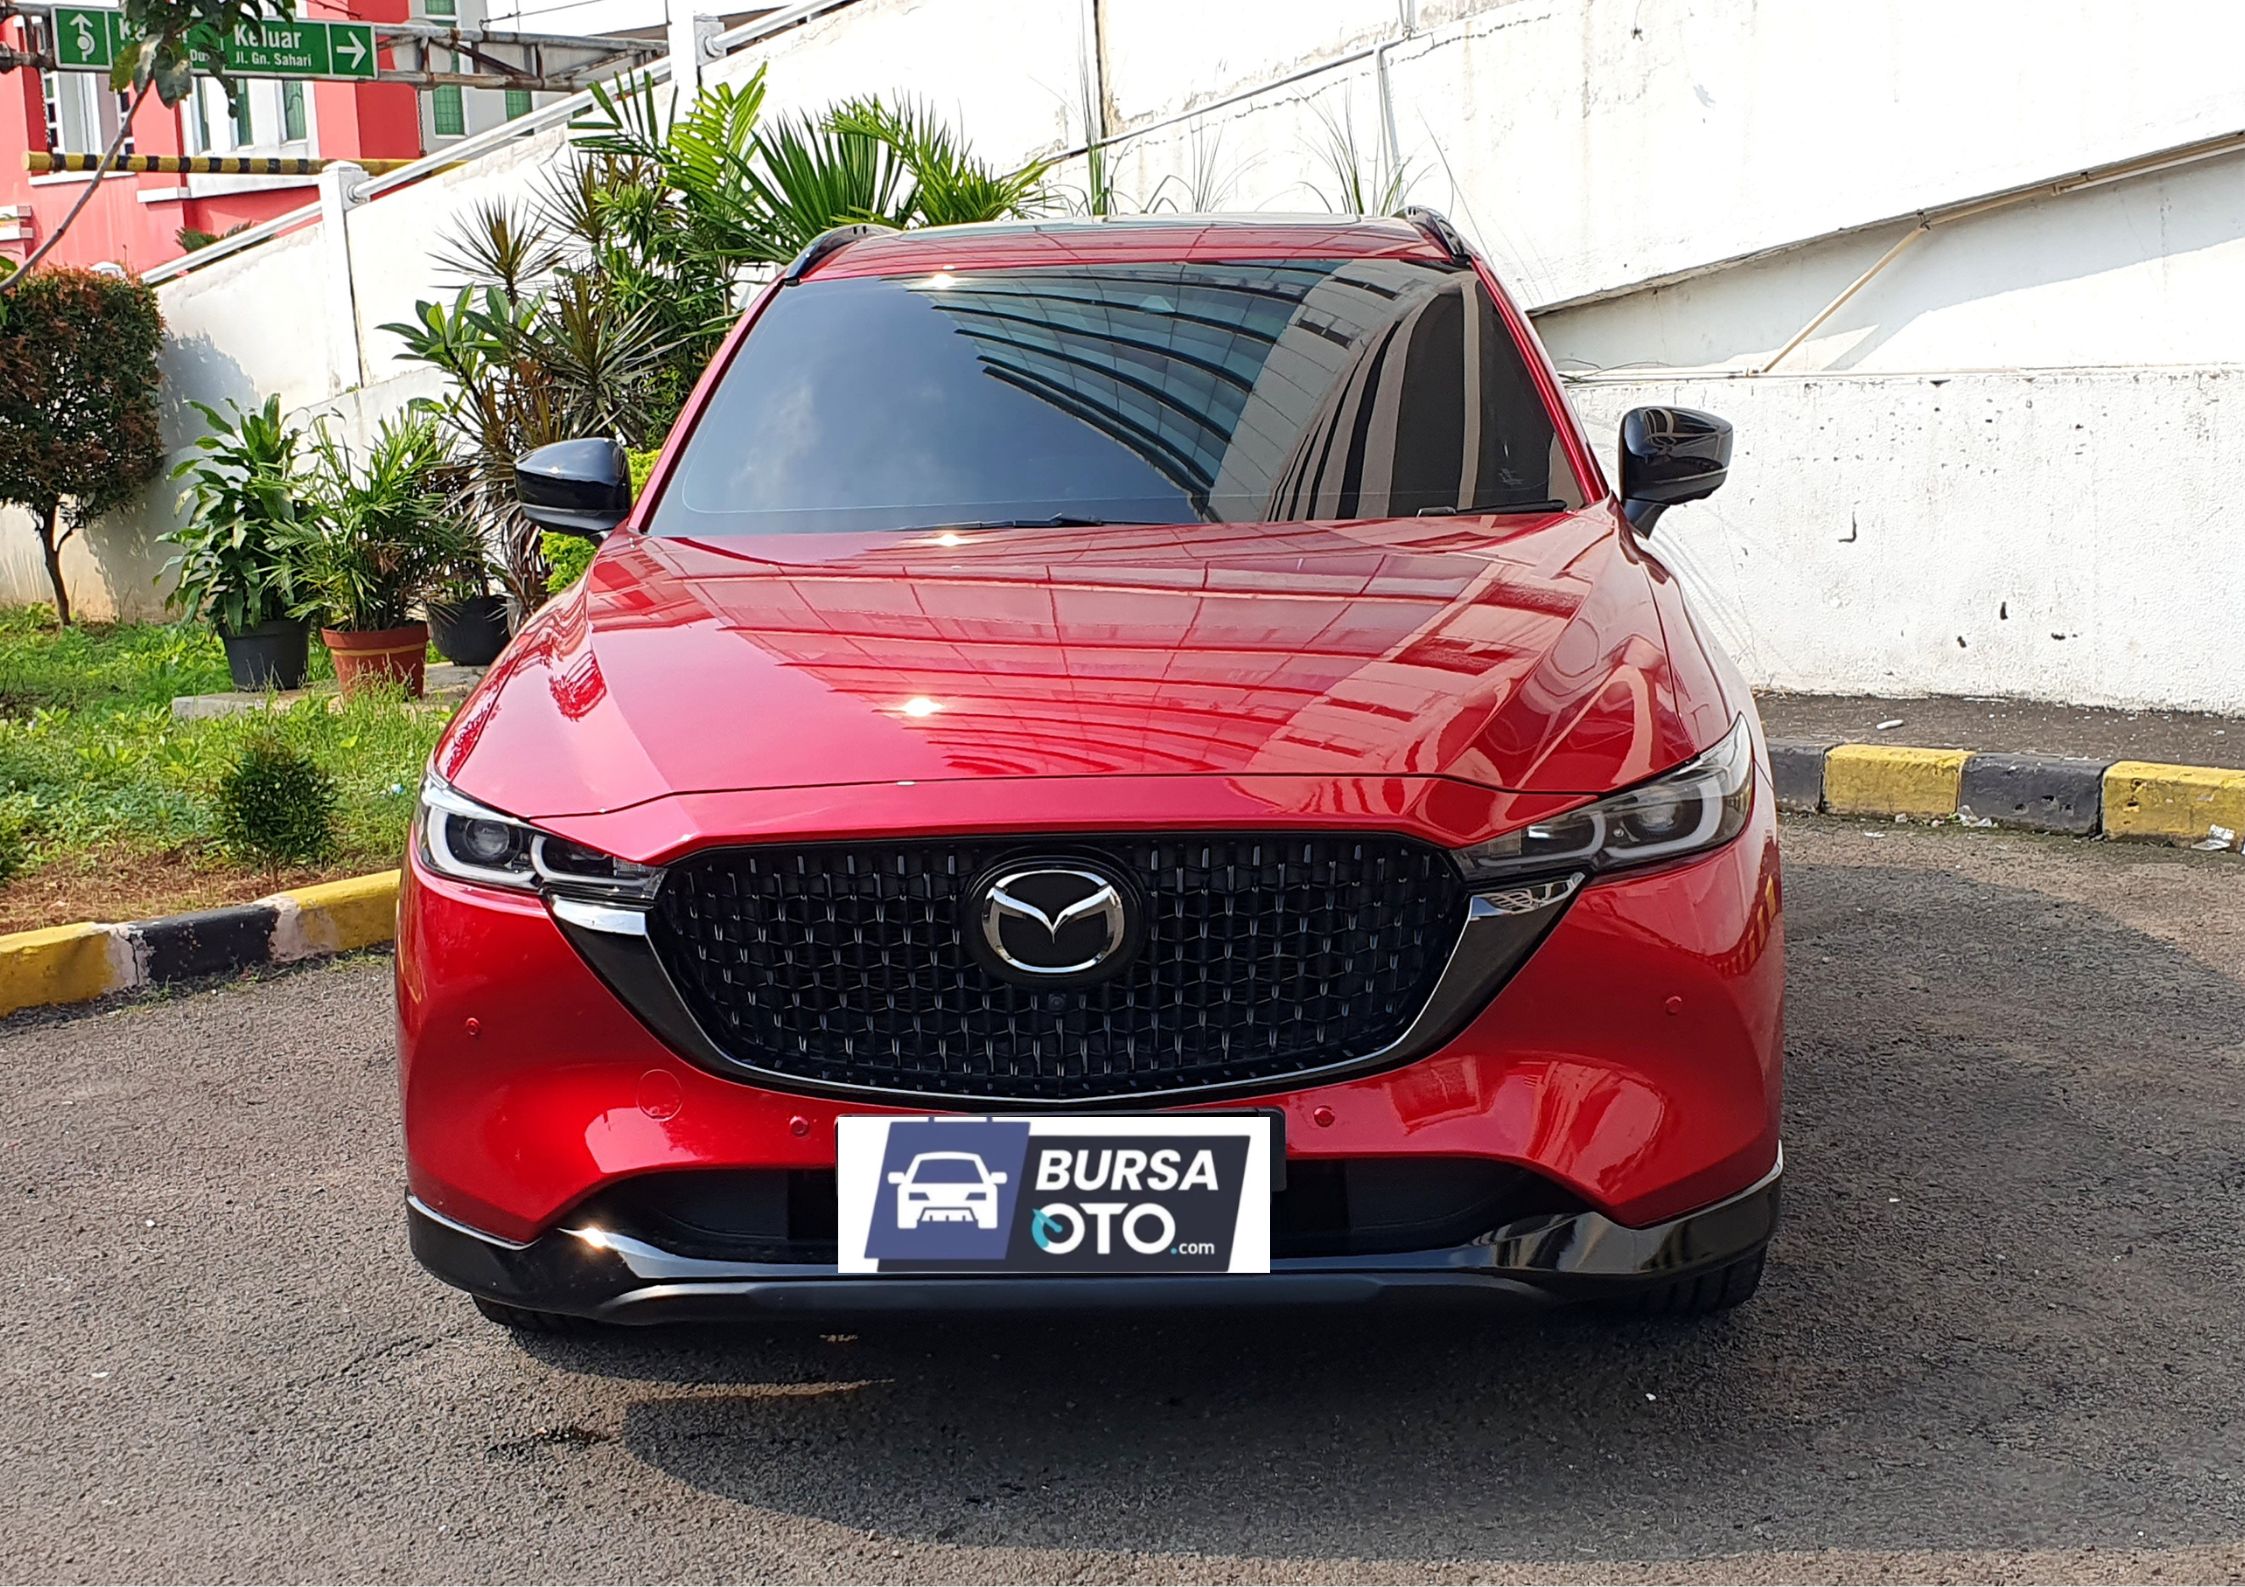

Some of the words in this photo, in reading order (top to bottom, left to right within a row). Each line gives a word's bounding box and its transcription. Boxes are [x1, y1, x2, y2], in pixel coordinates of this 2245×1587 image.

[233, 24, 302, 49] Keluar
[235, 51, 248, 64] Jl.
[251, 52, 270, 65] Gn.
[273, 53, 312, 67] Sahari
